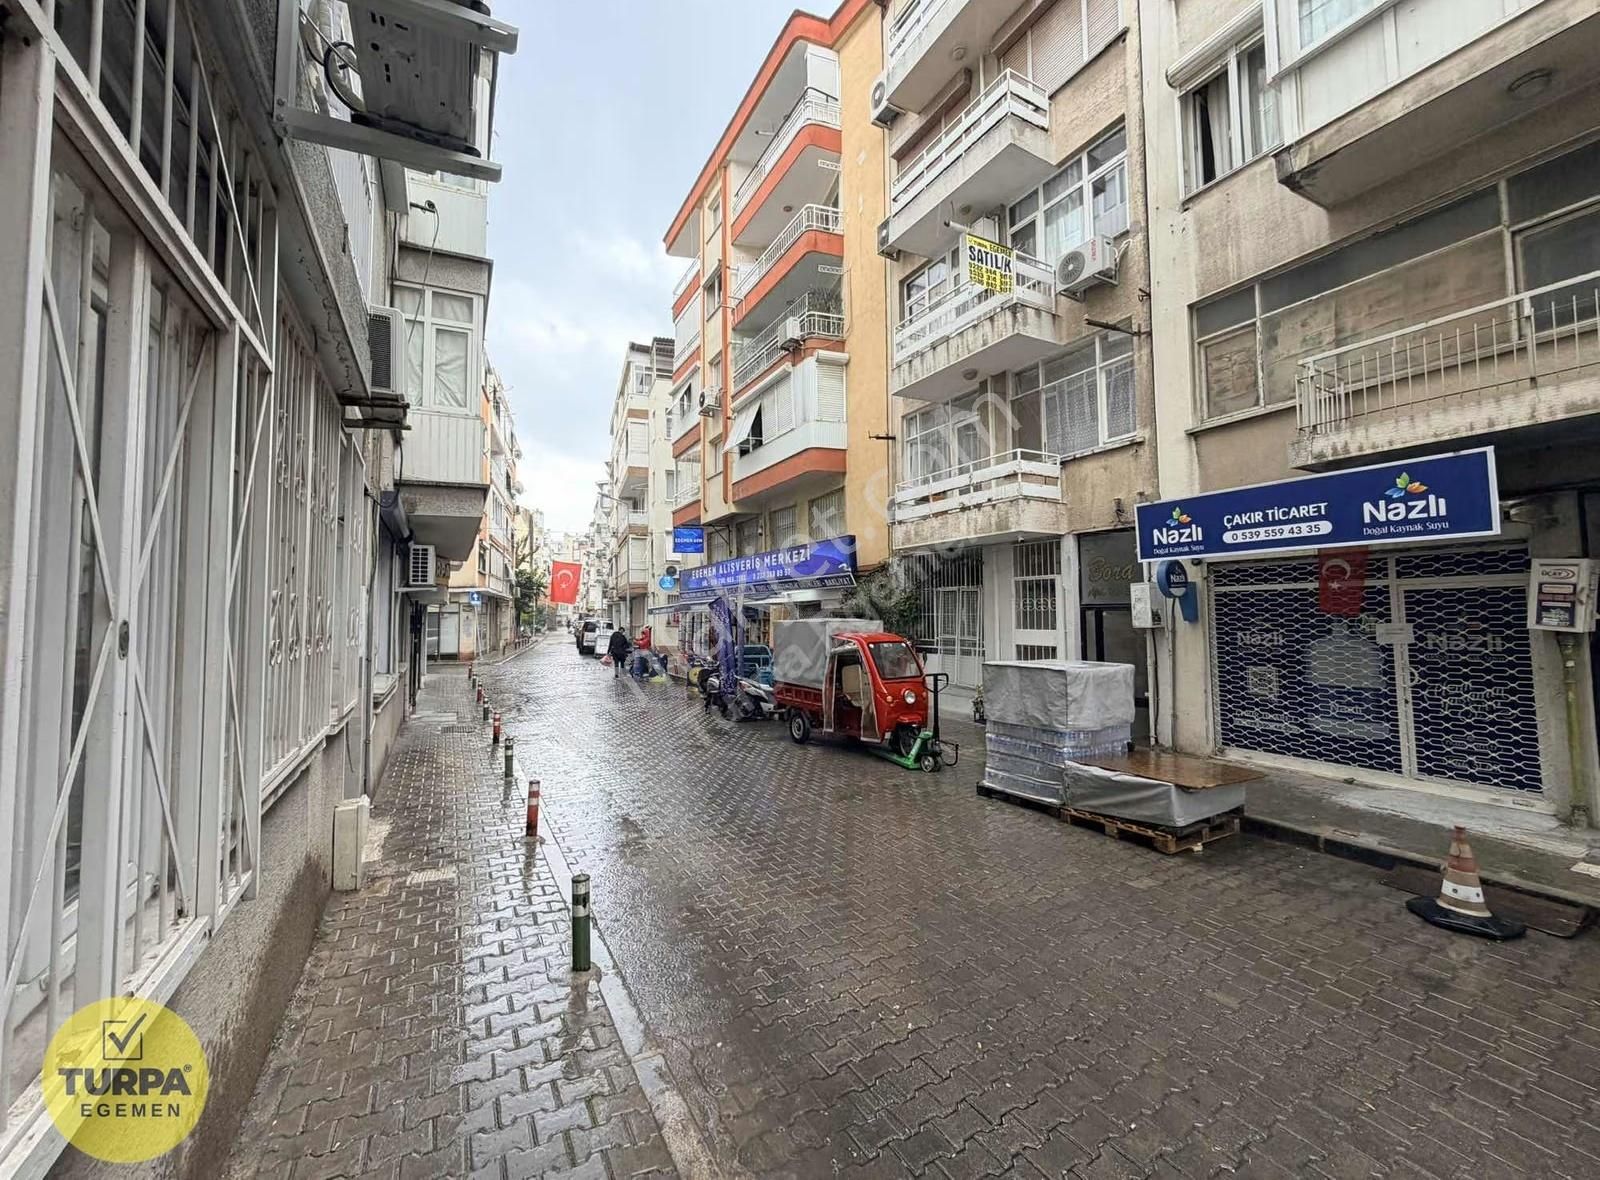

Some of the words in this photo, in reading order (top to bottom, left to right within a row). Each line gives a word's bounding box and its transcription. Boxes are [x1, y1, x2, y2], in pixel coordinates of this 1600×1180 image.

[968, 245, 1012, 273] SATILIK
[1223, 511, 1264, 529] ÇAKIR
[1266, 502, 1329, 521] TİCARET
[1363, 494, 1447, 523] Nazlı
[1153, 524, 1203, 546] Nazlı
[1231, 533, 1239, 541] 0
[1241, 530, 1261, 541] 539
[1264, 527, 1285, 538] 559
[1288, 526, 1303, 535] 43
[1306, 523, 1321, 534] 35
[1363, 526, 1388, 536] Doğal
[1389, 523, 1424, 533] Kaynak
[1426, 521, 1450, 531] Suyu
[719, 555, 760, 575] ALIŞVERİŞ
[764, 544, 811, 567] MERKEZİ
